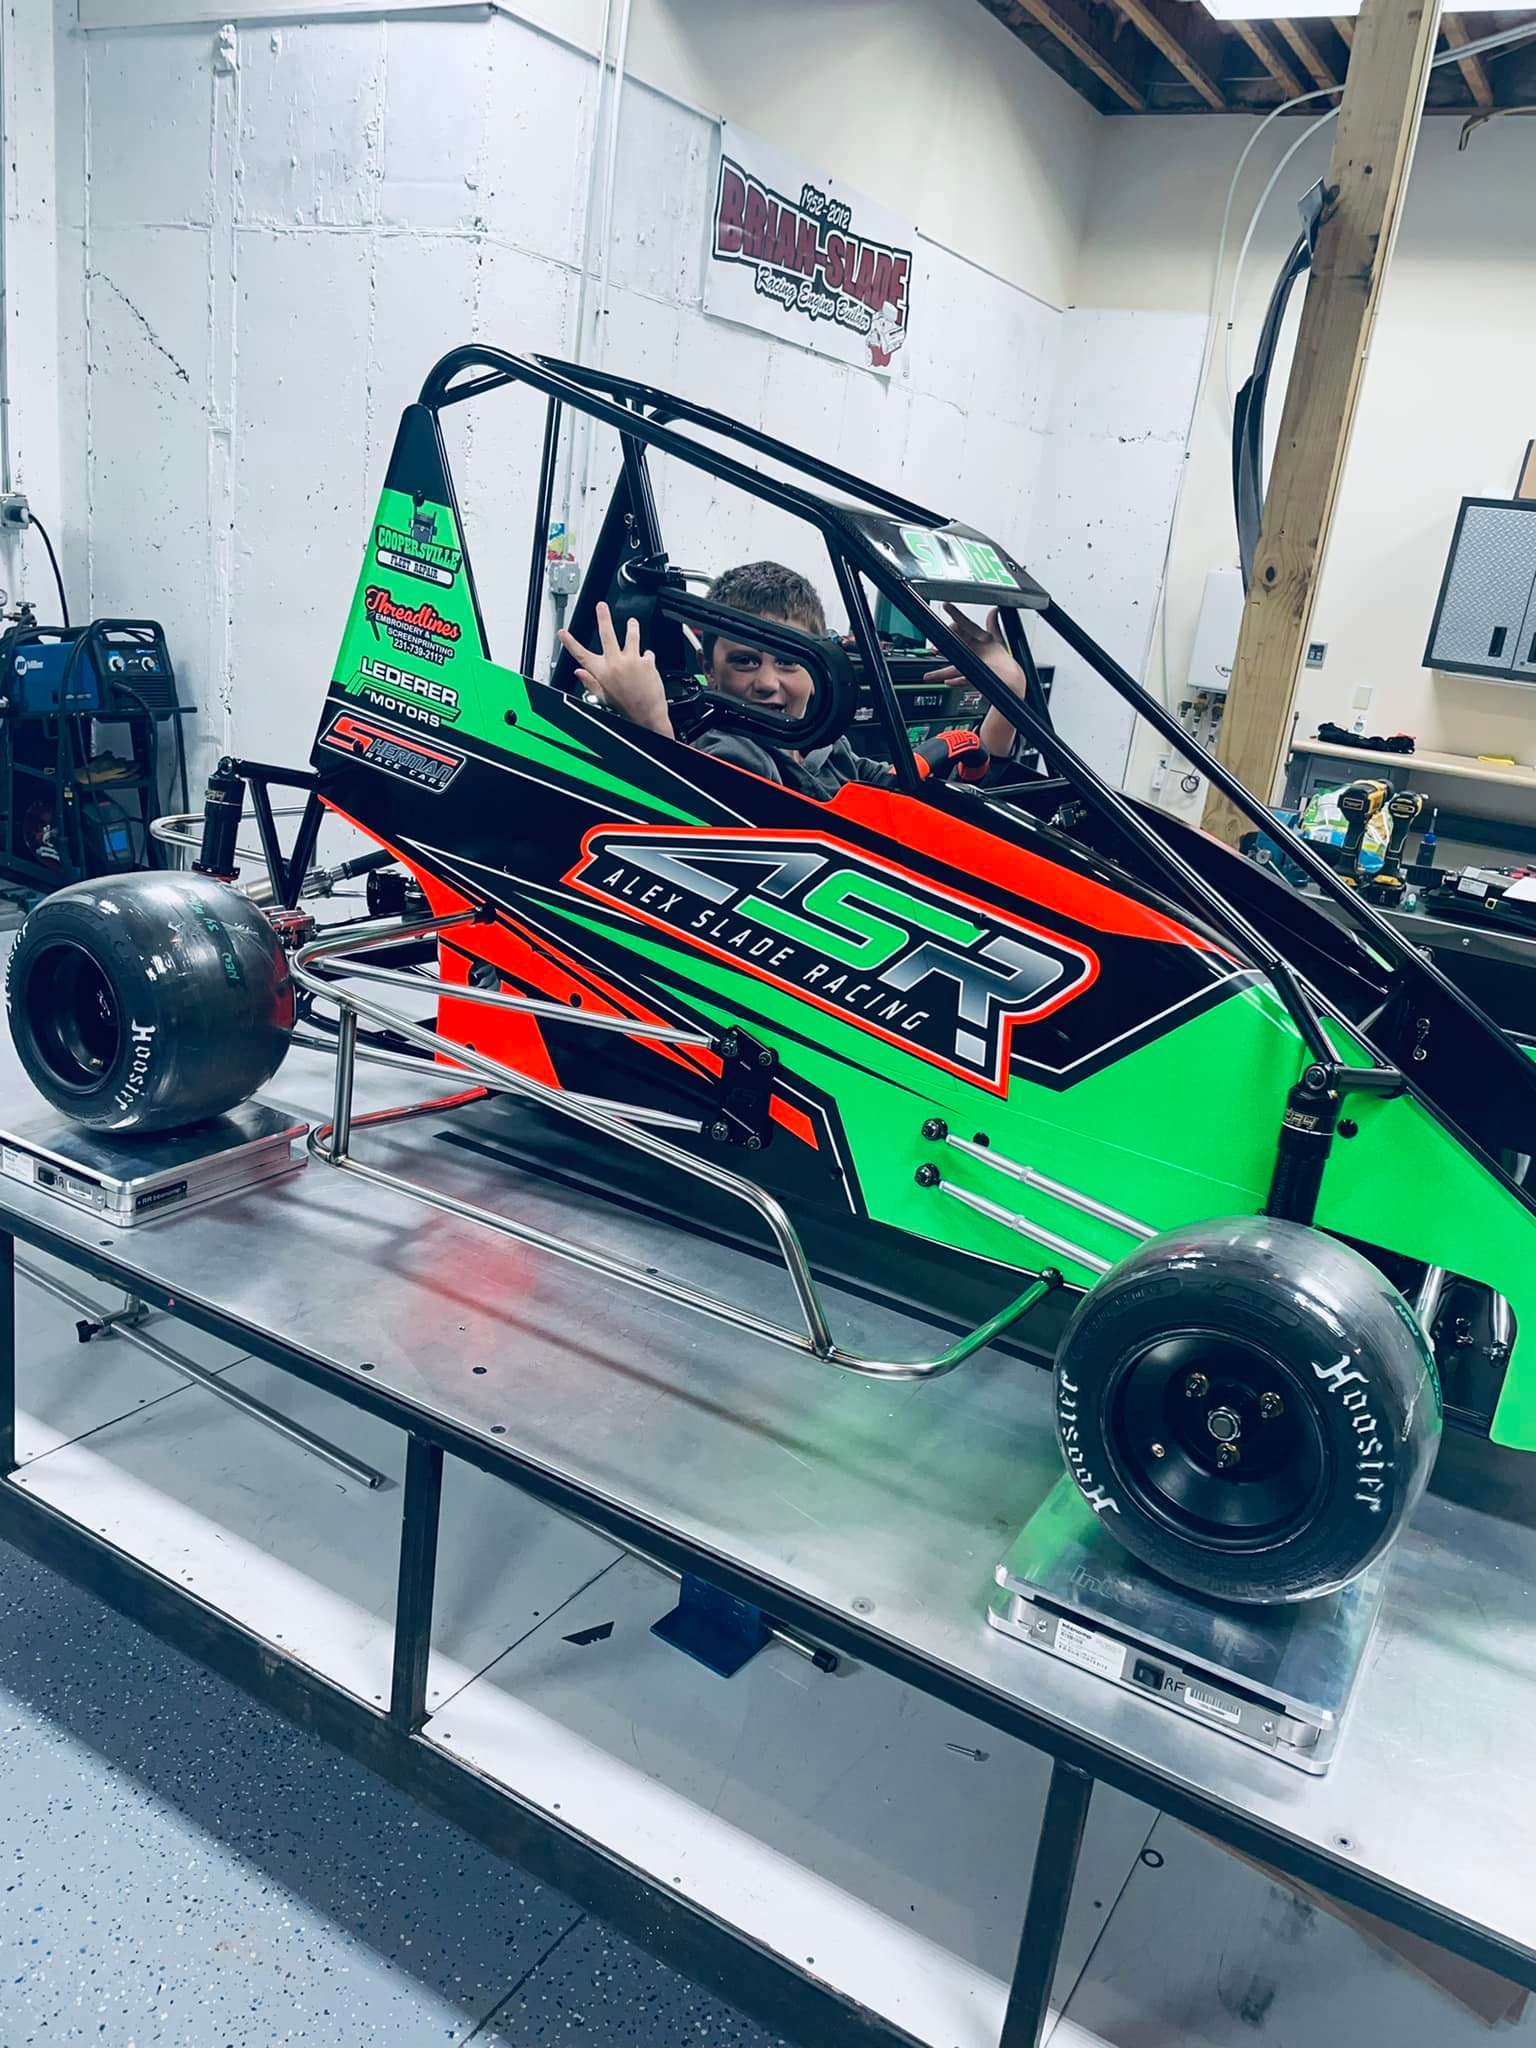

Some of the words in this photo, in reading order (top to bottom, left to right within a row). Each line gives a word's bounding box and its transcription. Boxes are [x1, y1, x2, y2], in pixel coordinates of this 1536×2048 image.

[757, 267, 797, 304] Racing
[798, 284, 835, 316] Engine
[378, 526, 460, 571] COOPERSVILLE
[390, 555, 411, 570] FLEET
[414, 563, 438, 579] REPAIR
[366, 588, 458, 638] Threadlines
[375, 613, 424, 636] EMBROIDERY
[388, 627, 453, 657] SCREENPRINTING
[361, 657, 458, 707] LEDERER
[370, 691, 440, 728] MOTORS
[365, 752, 401, 770] RACE
[409, 770, 446, 788] CARS
[602, 867, 684, 914] ALEX
[690, 904, 796, 968] SLADE
[803, 962, 931, 1032] RACING
[114, 1018, 156, 1111] Hoosier
[1060, 1369, 1121, 1514] Hoosier
[1311, 1354, 1394, 1512] Hoosier
[1163, 1677, 1186, 1693] RF
